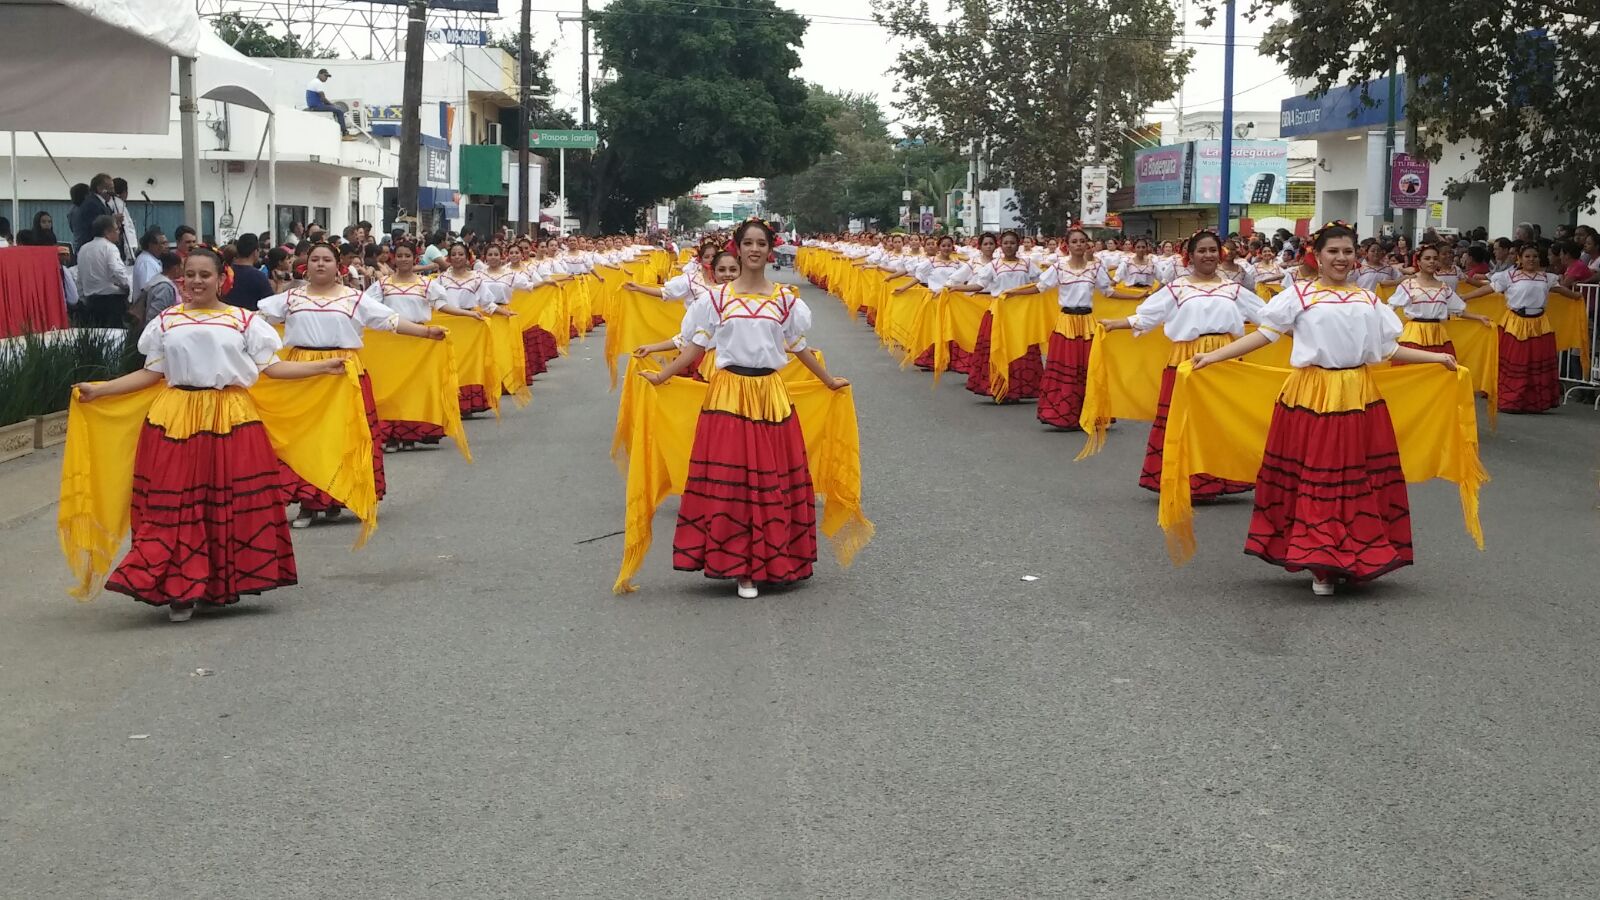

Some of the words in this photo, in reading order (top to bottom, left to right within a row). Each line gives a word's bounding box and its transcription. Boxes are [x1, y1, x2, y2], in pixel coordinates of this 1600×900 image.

[1295, 108, 1321, 125] Bancomer
[541, 133, 568, 142] Raspas
[1206, 148, 1219, 156] La
[1141, 160, 1149, 178] La
[1149, 155, 1177, 181] Bodeguita
